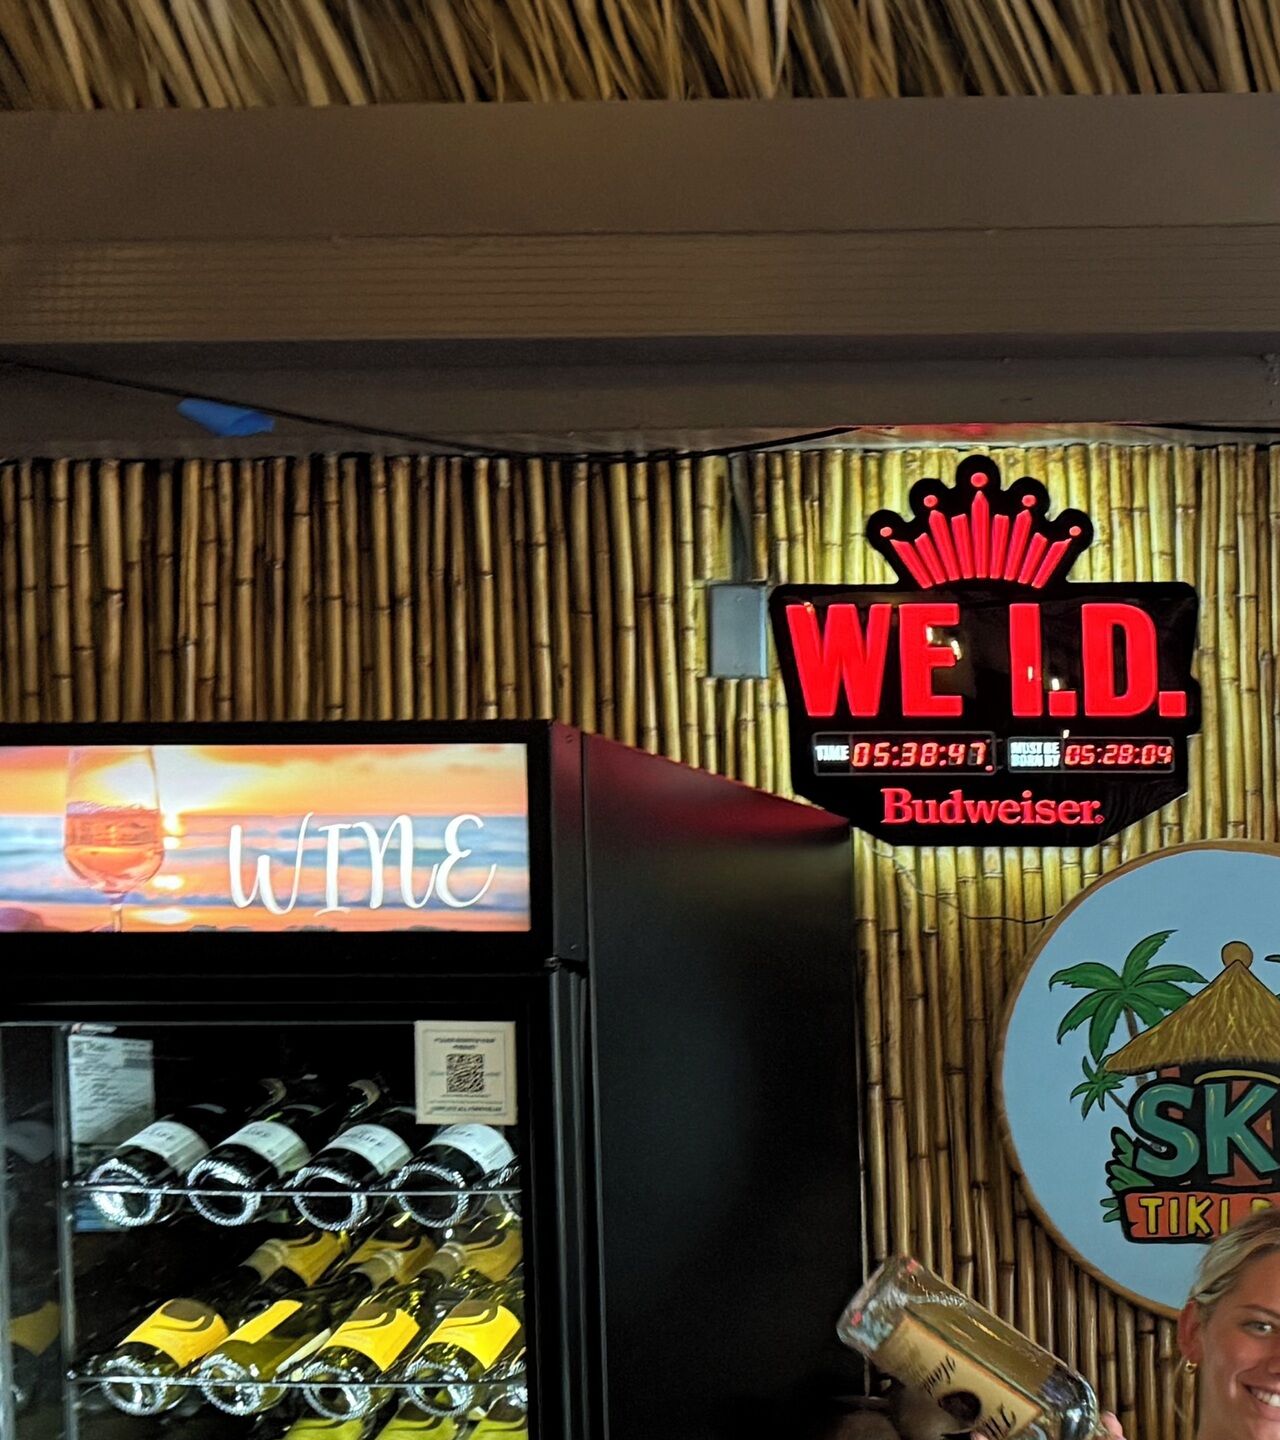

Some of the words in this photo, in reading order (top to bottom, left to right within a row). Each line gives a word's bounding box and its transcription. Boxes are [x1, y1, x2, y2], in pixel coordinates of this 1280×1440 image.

[786, 603, 963, 717] WE
[1009, 603, 1187, 717] I.D.
[815, 744, 850, 762] TIME
[1064, 744, 1173, 765] 05:28:04
[880, 787, 1105, 825] Budweiser
[229, 812, 498, 916] WINE
[1139, 1196, 1230, 1236] TIKI
